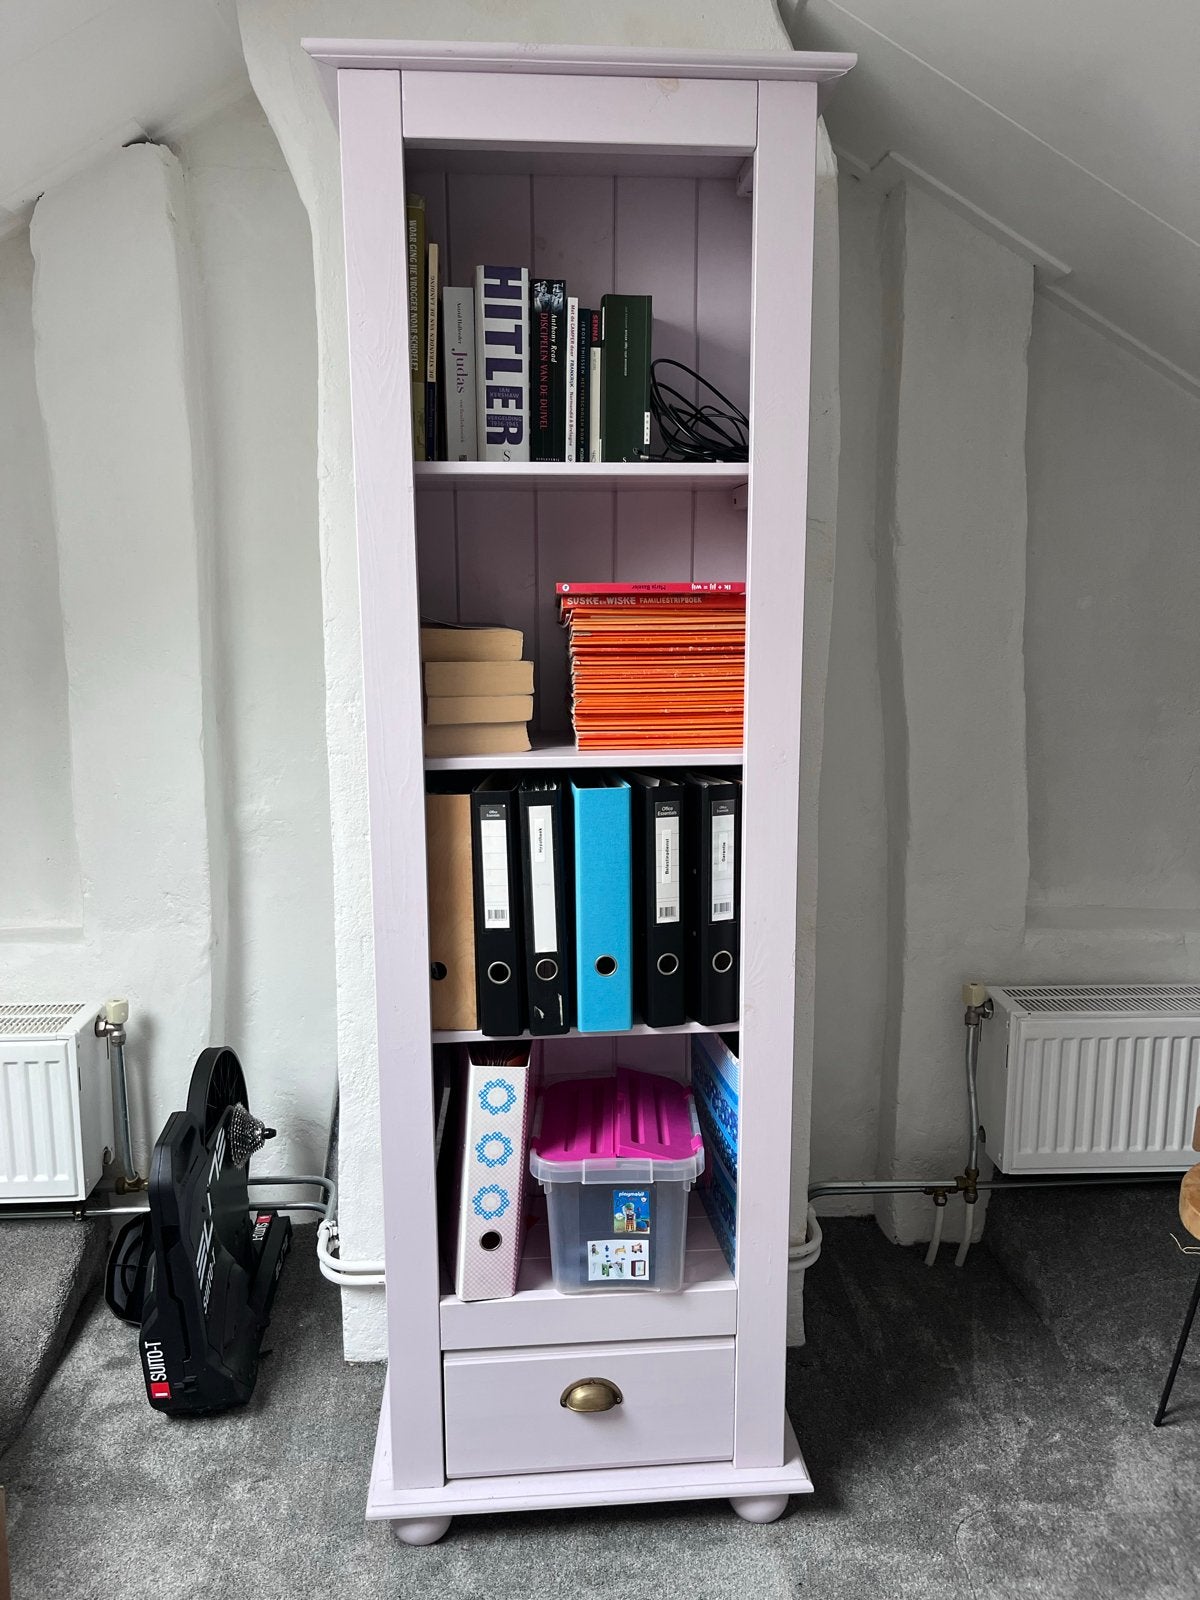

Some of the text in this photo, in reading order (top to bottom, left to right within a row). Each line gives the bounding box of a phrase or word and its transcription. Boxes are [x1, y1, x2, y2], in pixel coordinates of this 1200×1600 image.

[408, 220, 418, 243] WOAR
[408, 244, 418, 263] GING
[409, 276, 418, 311] VROGGER
[410, 312, 419, 333] NOAR
[550, 313, 558, 363] Anthony Read
[591, 313, 599, 342] SENNA
[451, 348, 468, 394] Judas
[484, 265, 523, 445] HITLER
[539, 312, 549, 430] DISCIPELEN VAN DE DUIVEL
[567, 597, 599, 606] SUSKE
[607, 596, 636, 605] WISKE
[639, 596, 702, 604] FAMILIESTRIPBOEK
[145, 1341, 167, 1381] SUITO-T
